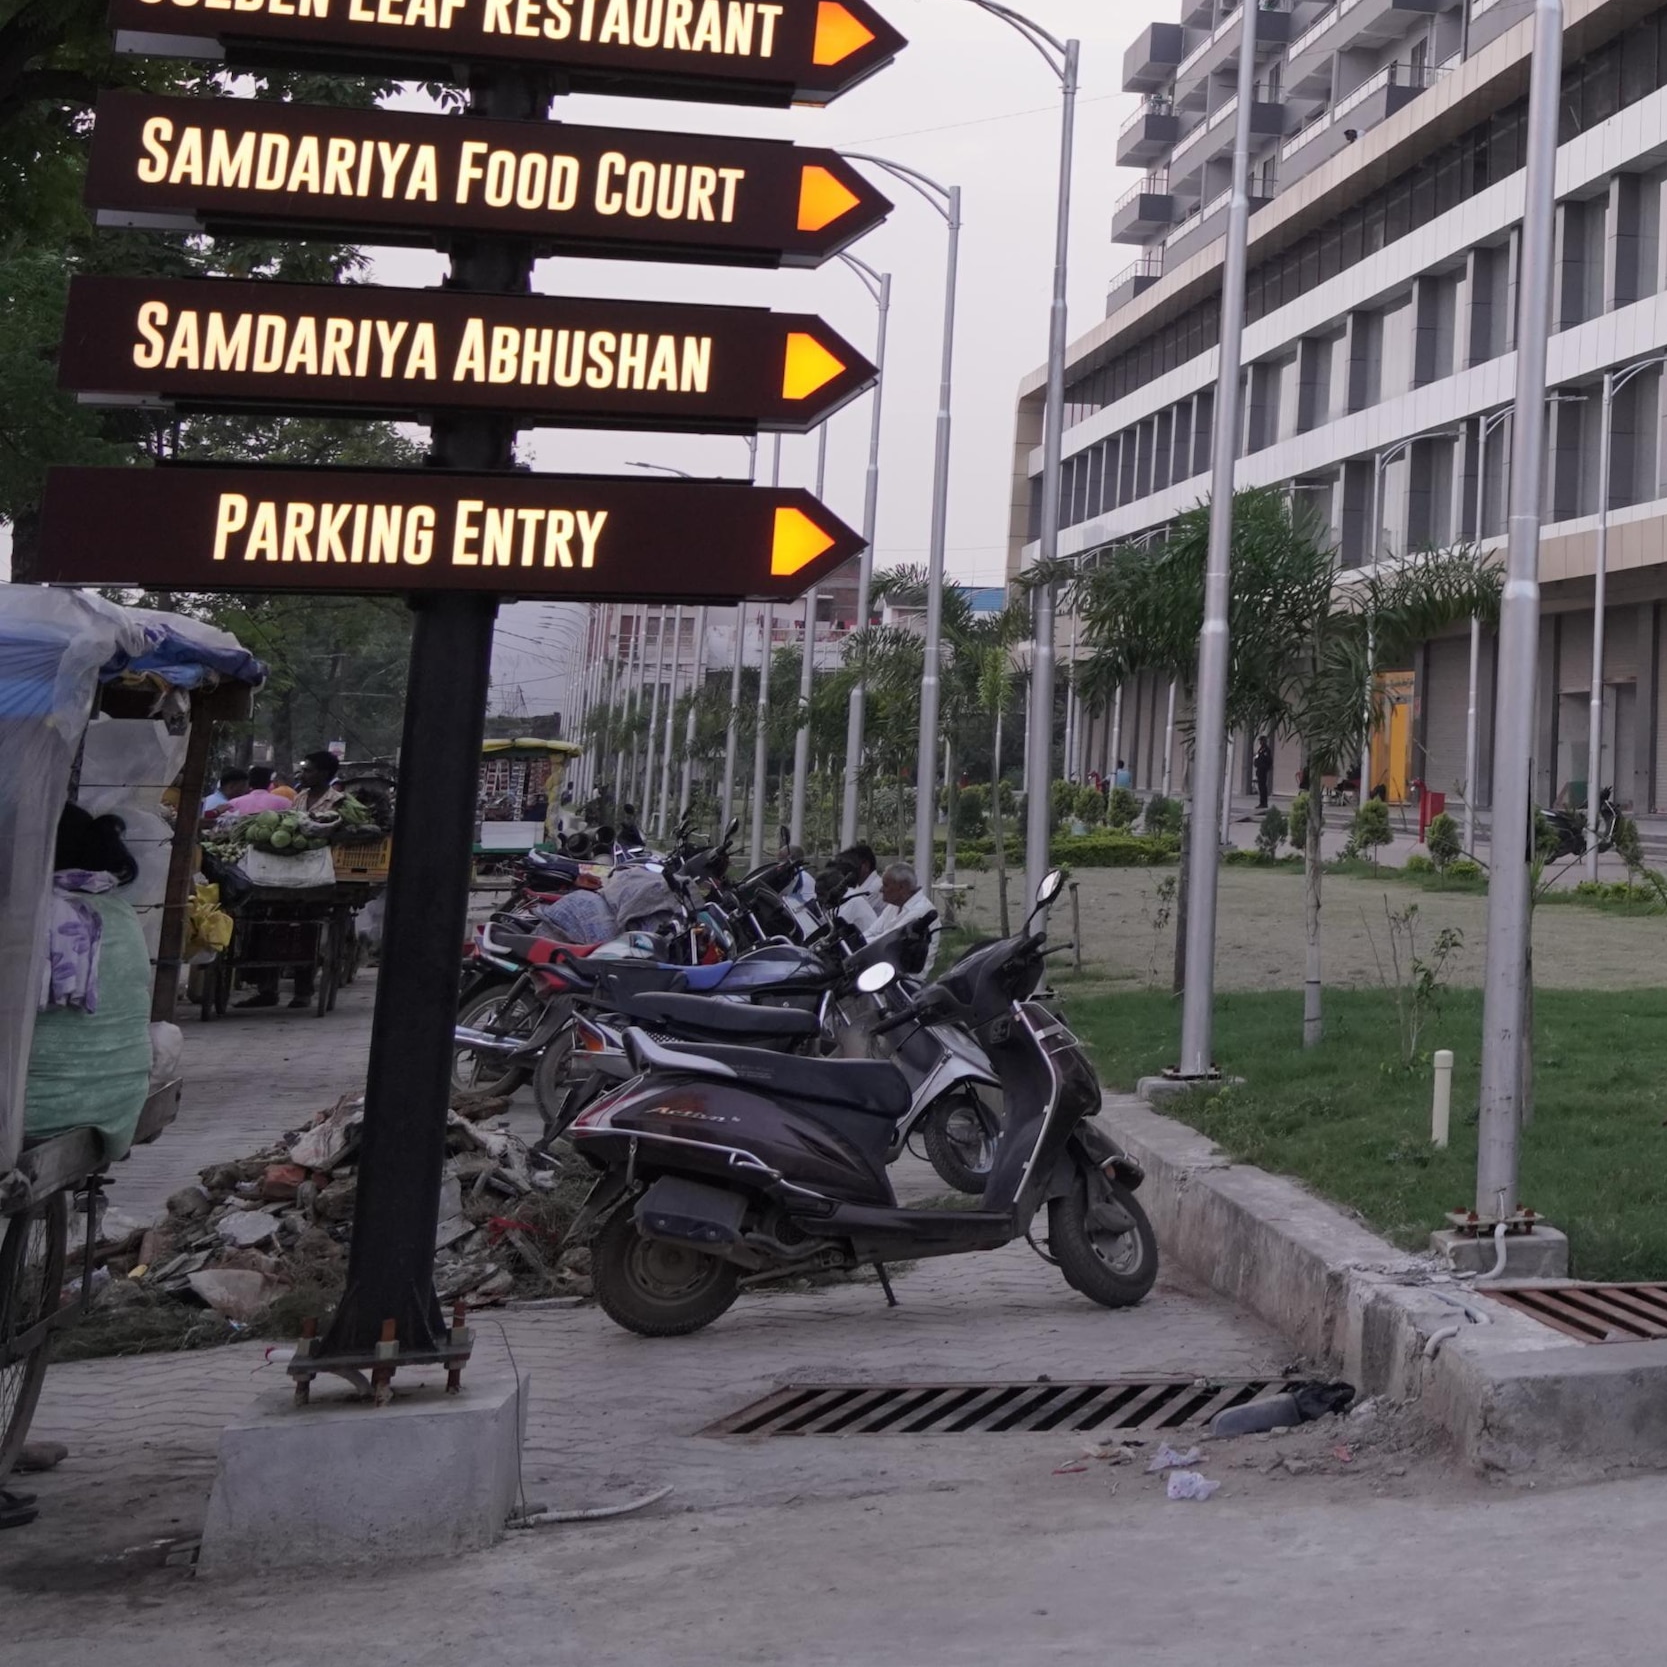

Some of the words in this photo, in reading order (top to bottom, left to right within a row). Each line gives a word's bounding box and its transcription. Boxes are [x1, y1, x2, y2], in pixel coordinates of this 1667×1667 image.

[137, 116, 438, 202] SAMDARIYA
[455, 141, 580, 211] FOOD
[594, 151, 745, 223] COURT
[133, 301, 437, 380] SAMDARIYA
[453, 318, 712, 393] ABHUSHAN
[213, 493, 436, 565] PARKING
[452, 499, 608, 568] ENTRY
